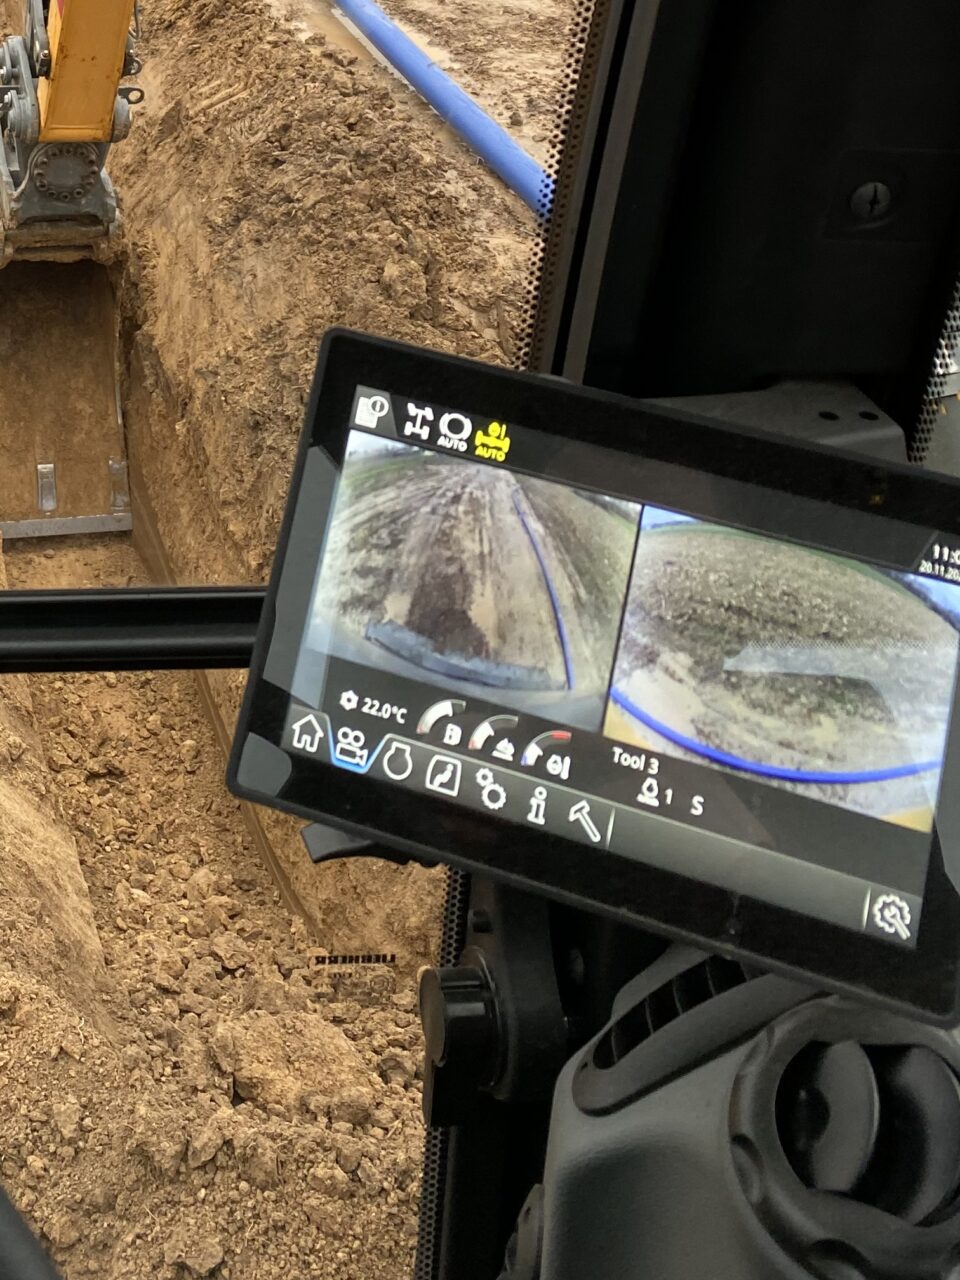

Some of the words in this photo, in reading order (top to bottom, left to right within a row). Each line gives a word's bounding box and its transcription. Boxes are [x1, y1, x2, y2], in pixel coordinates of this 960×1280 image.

[437, 435, 468, 452] AUTO
[475, 445, 506, 462] AUTO
[919, 559, 960, 582] 20.11.20
[361, 697, 408, 724] 22.0°C
[612, 746, 646, 771] Tool
[647, 757, 659, 775] 3
[665, 788, 673, 805] 1
[690, 795, 705, 816] S
